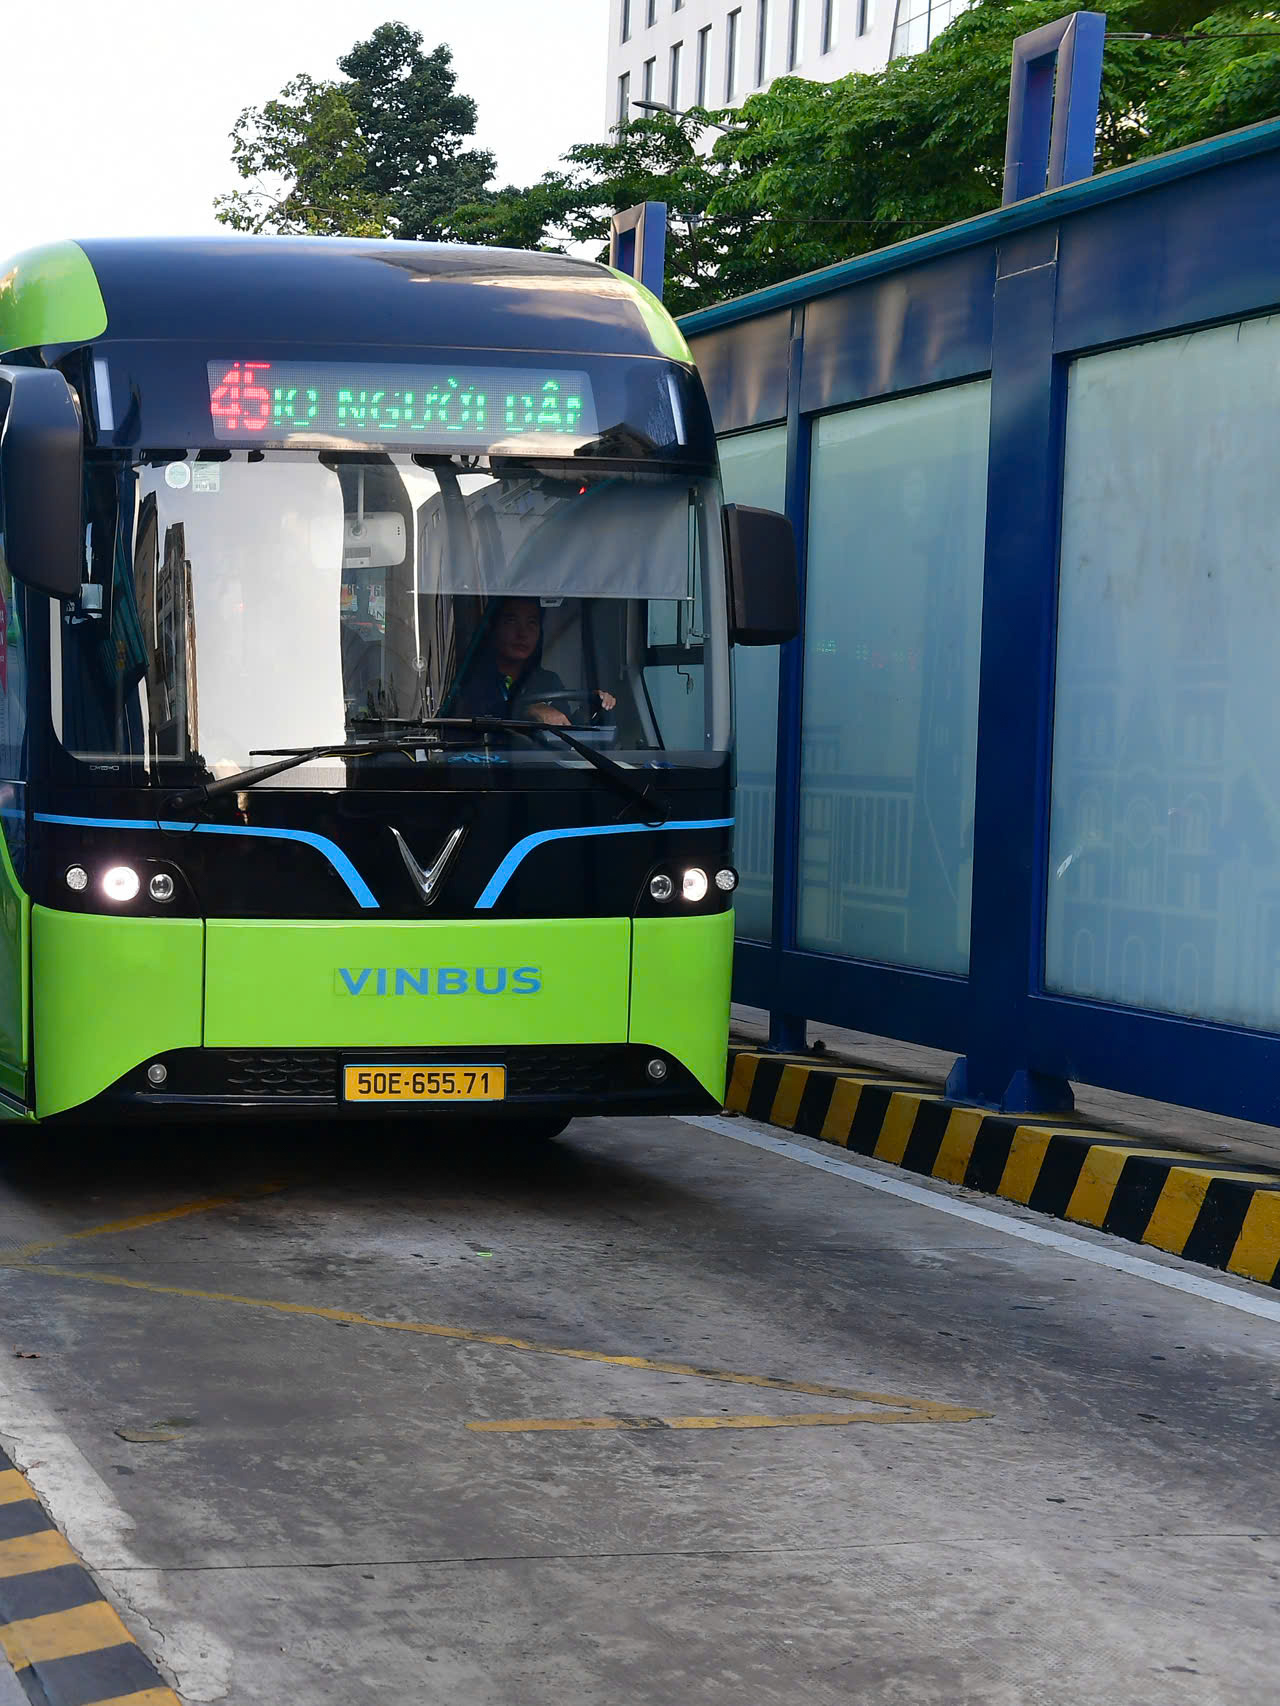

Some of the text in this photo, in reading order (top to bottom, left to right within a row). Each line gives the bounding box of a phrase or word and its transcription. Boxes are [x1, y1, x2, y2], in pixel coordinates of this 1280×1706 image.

[210, 362, 271, 430] 45
[338, 966, 543, 996] VINBUS
[358, 1072, 489, 1094] 50E-655.71
